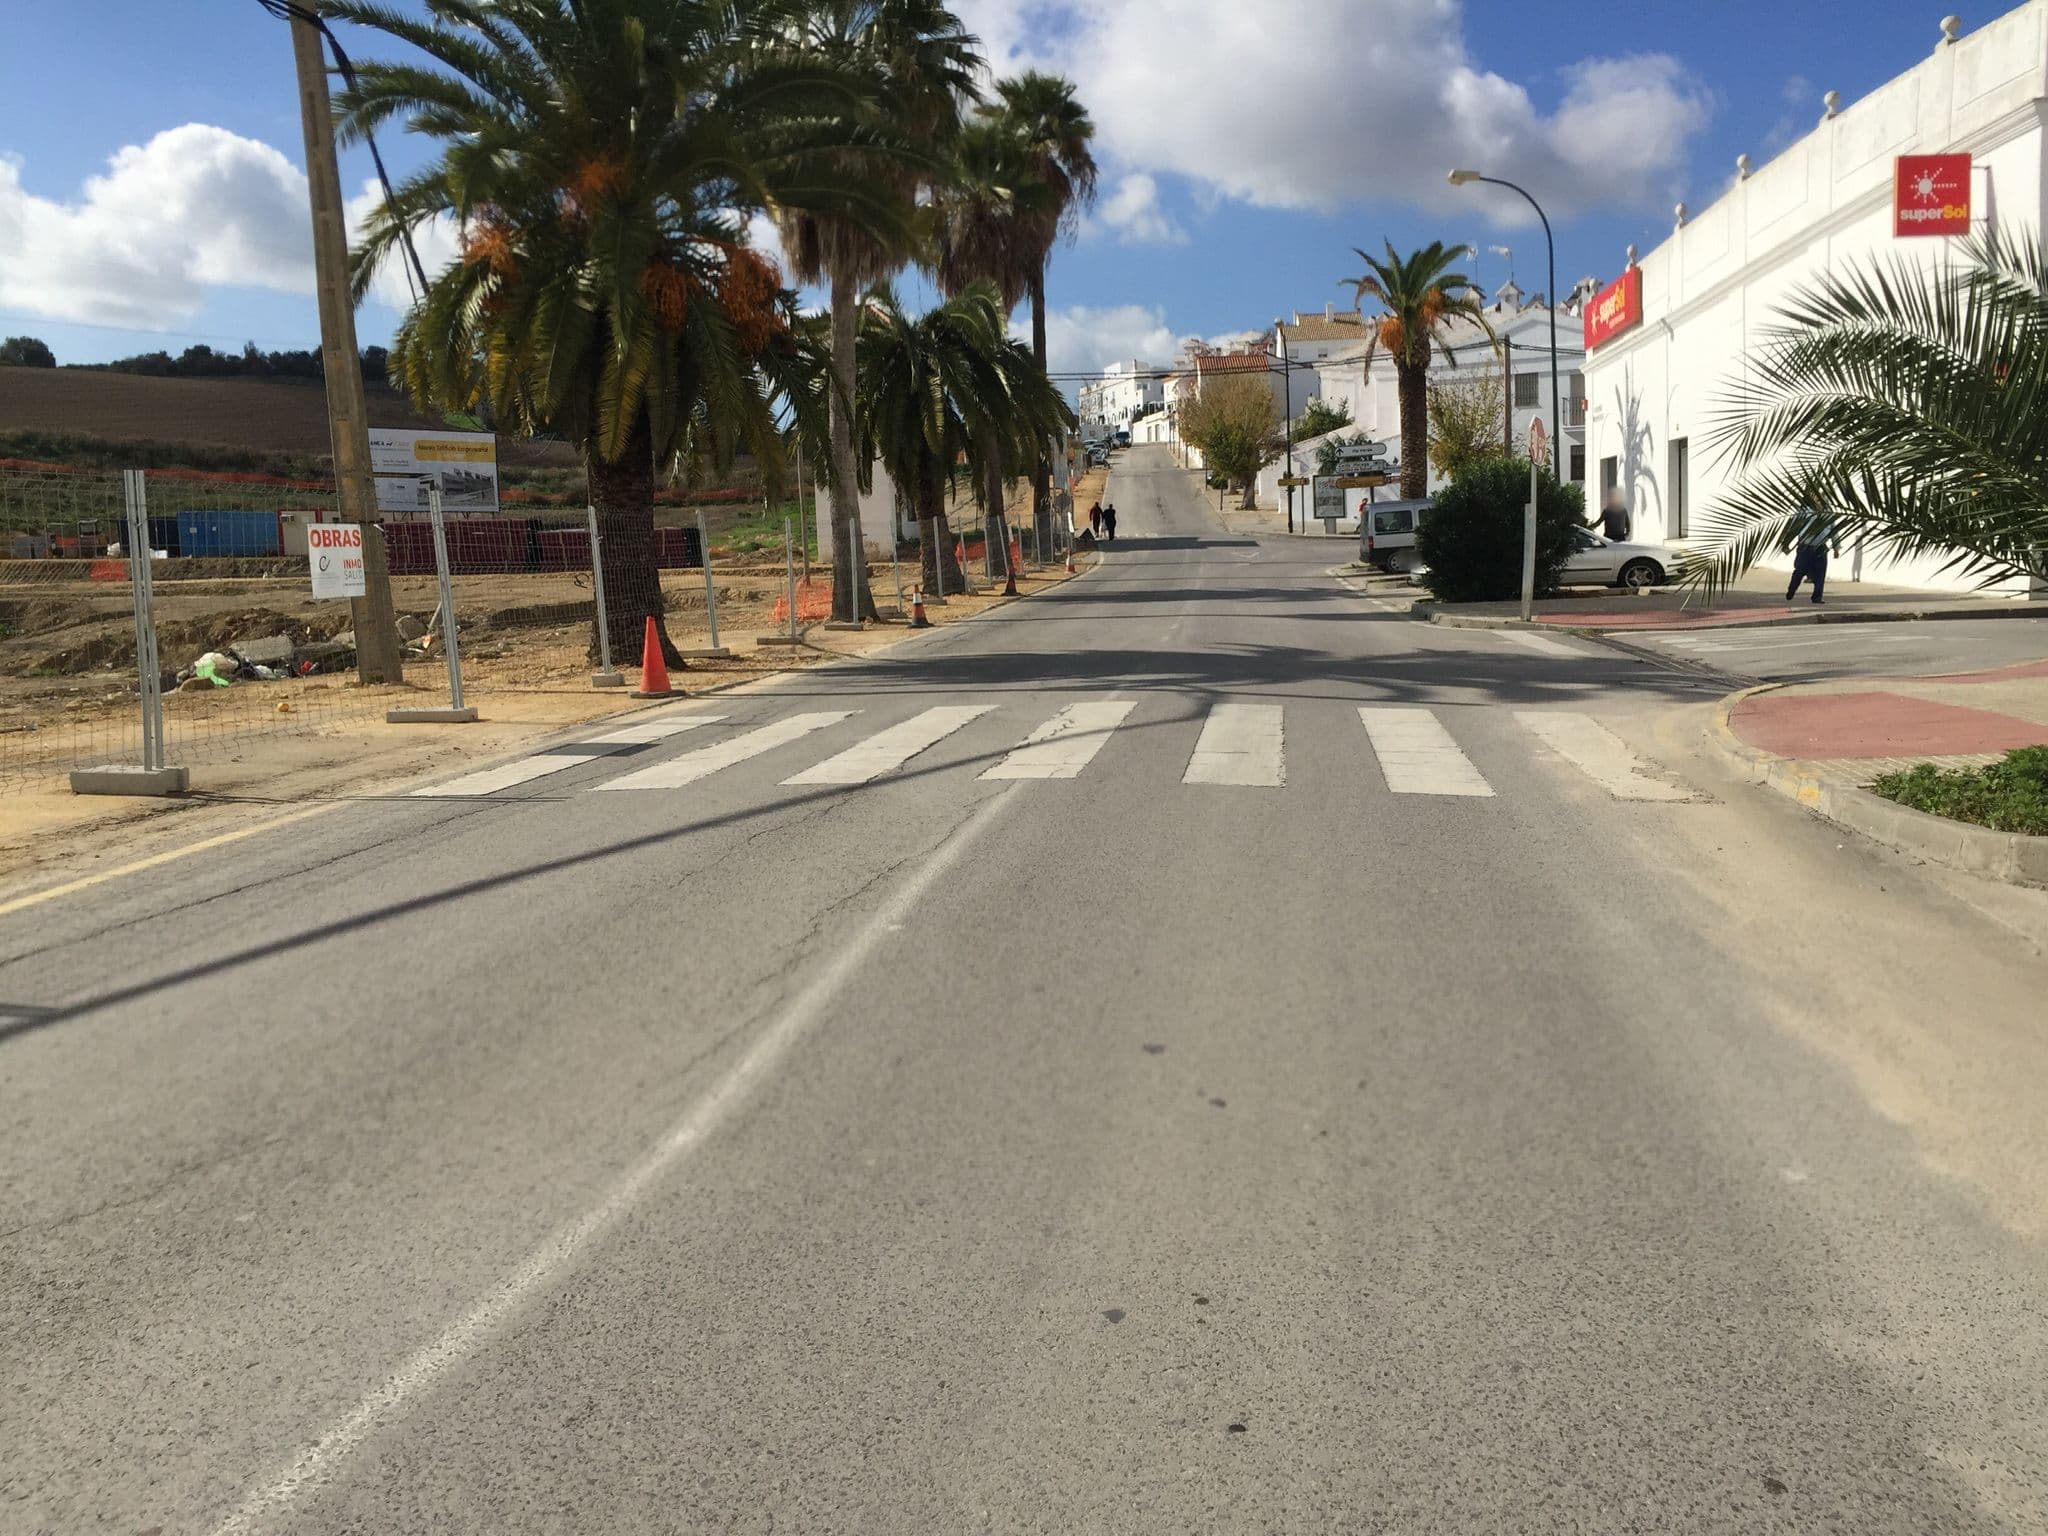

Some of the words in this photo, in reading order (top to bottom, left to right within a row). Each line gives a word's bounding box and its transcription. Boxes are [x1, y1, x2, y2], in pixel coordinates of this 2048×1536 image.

[1900, 204, 1967, 222] superSol
[1600, 279, 1625, 325] superSol
[310, 529, 361, 548] OBRAS
[343, 559, 362, 569] INMO
